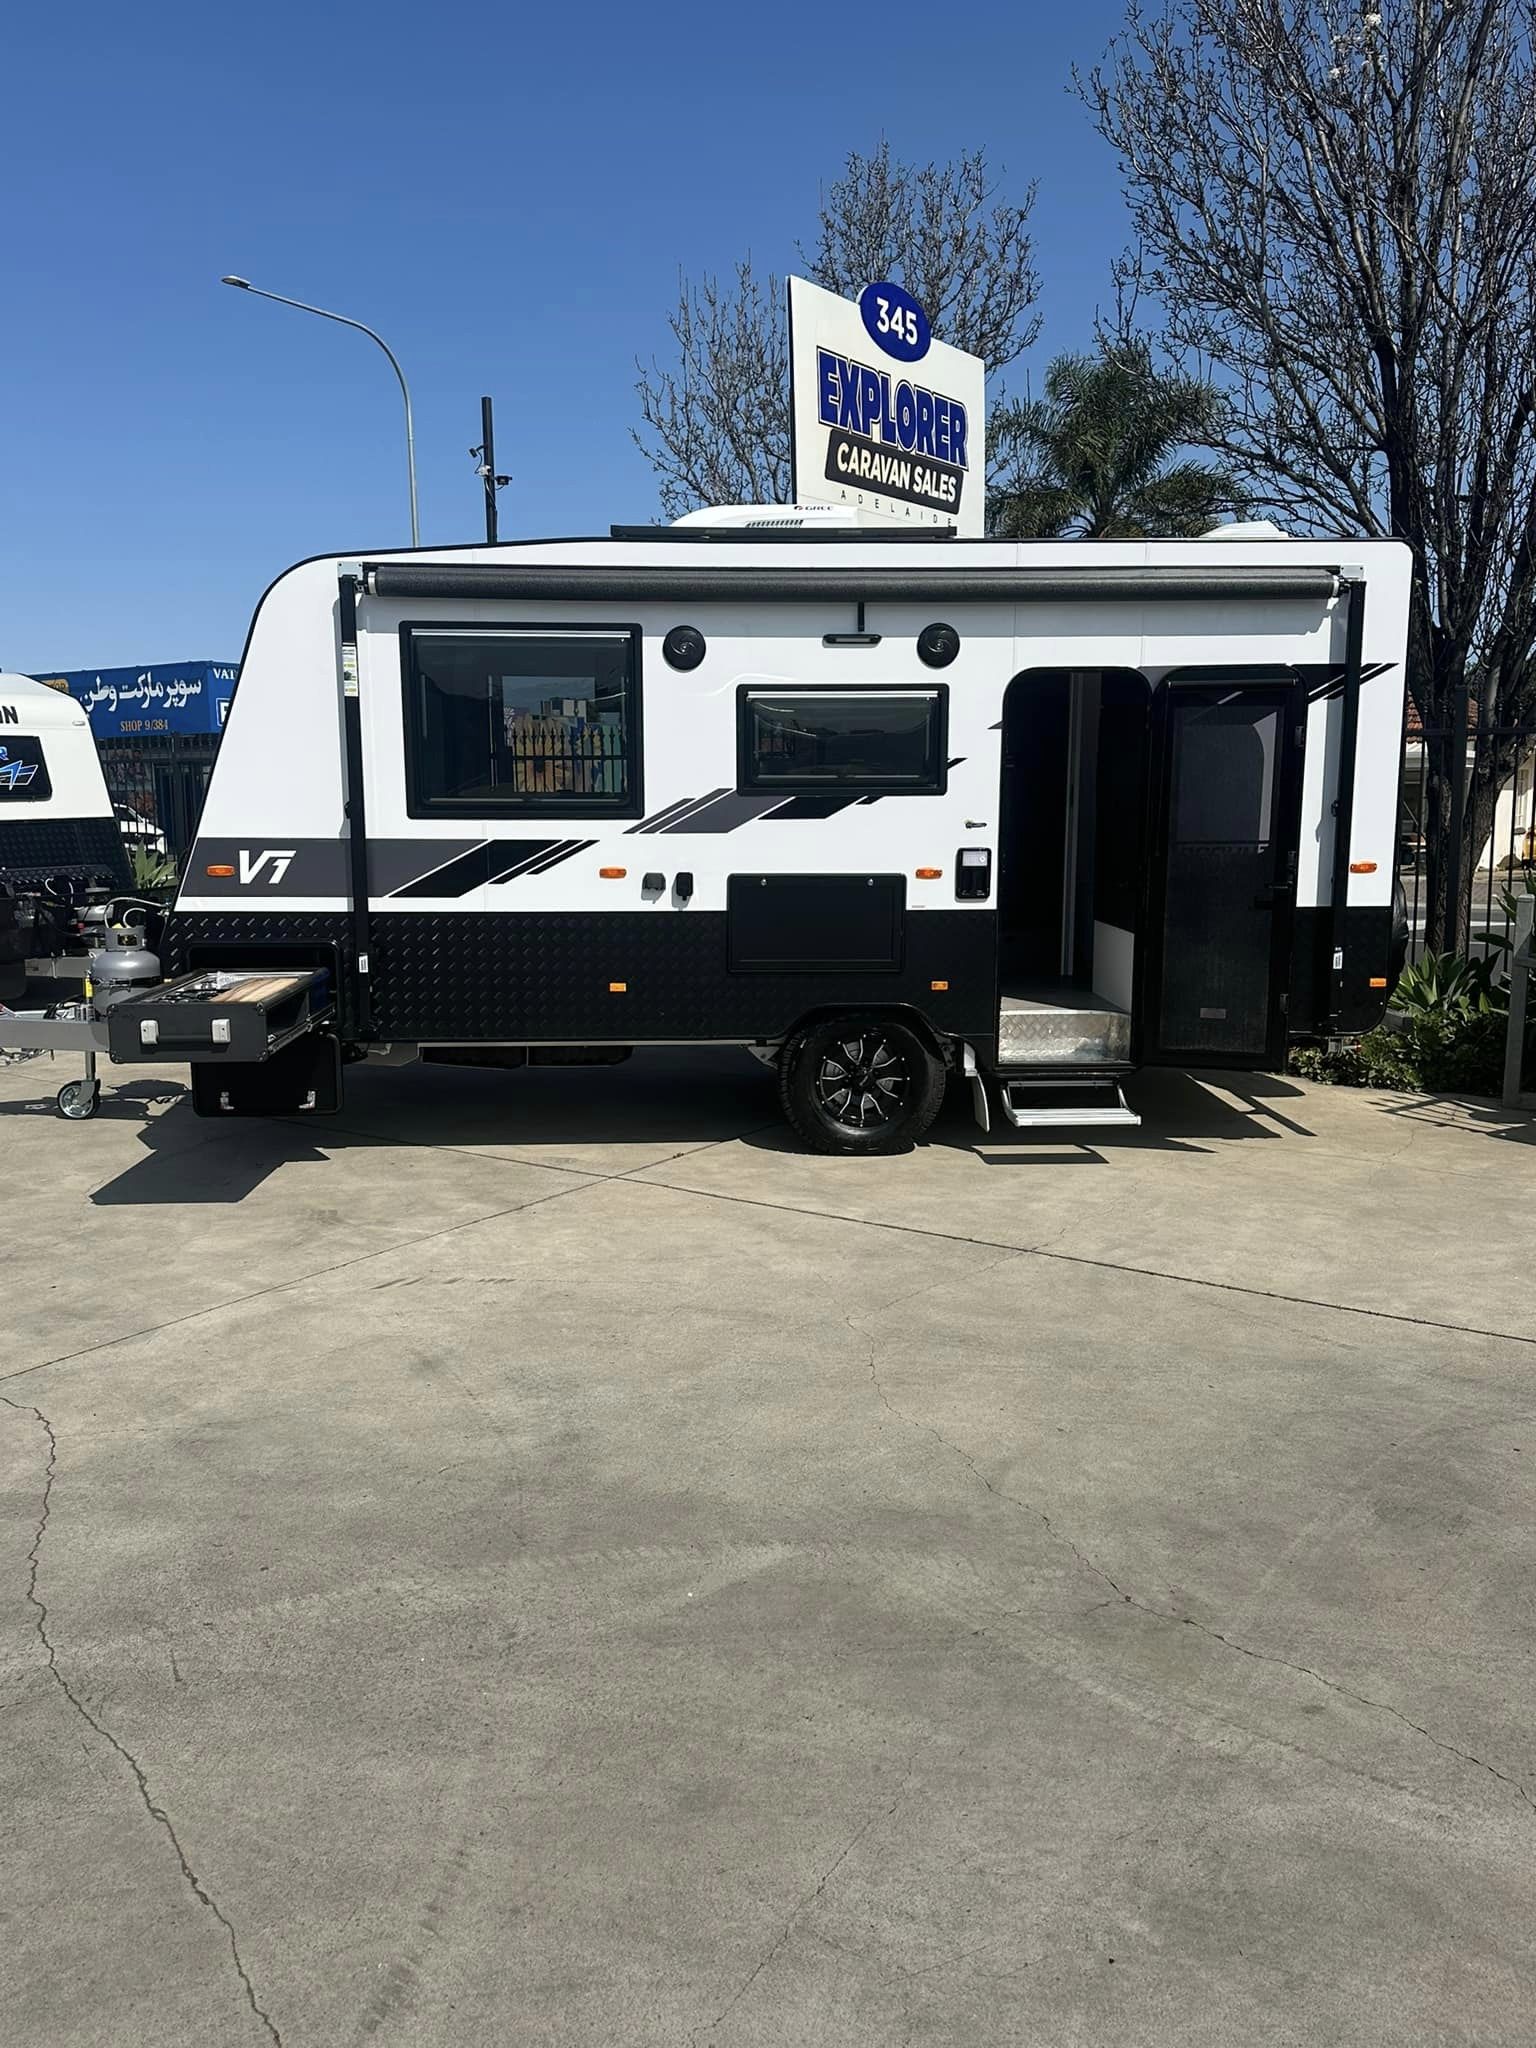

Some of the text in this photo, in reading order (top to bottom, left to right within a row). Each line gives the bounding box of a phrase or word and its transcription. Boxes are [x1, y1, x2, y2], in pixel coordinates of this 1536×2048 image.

[877, 297, 917, 345] 345
[816, 346, 969, 471] EXPLORER
[837, 442, 956, 503] CARAVAN SALES
[120, 720, 142, 731] SHOP
[239, 850, 296, 884] V1
